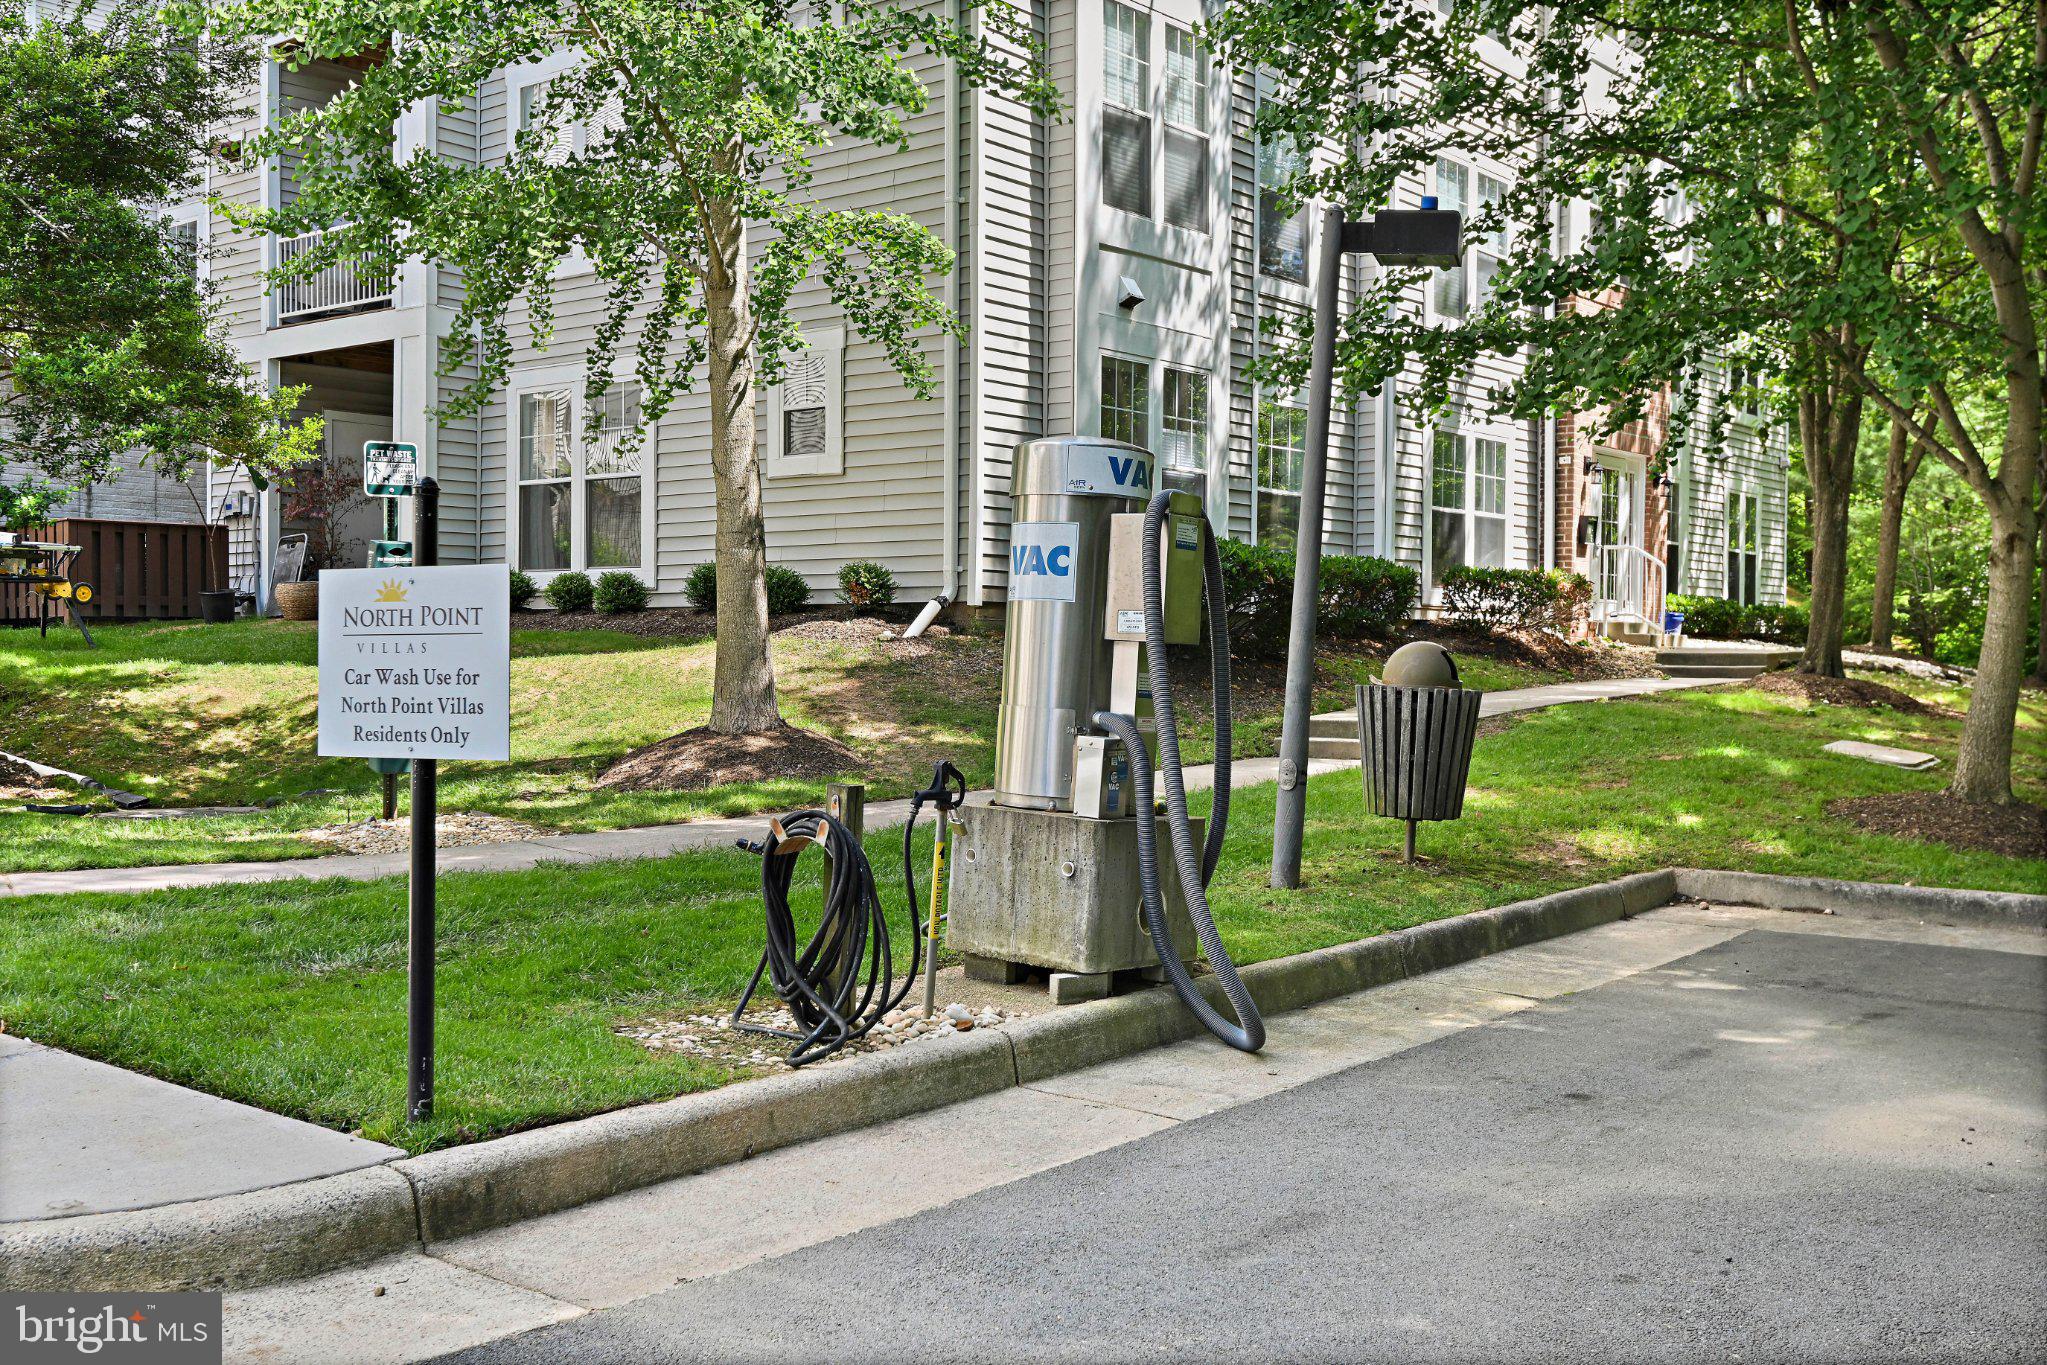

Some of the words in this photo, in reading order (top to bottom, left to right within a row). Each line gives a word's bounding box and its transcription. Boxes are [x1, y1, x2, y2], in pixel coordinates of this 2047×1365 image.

[370, 449, 384, 457] PET
[387, 450, 412, 458] WASTE
[1108, 456, 1152, 489] VA
[1013, 545, 1071, 576] VAC
[343, 606, 413, 628] NORTH
[420, 605, 483, 626] POINT
[357, 642, 427, 654] VILLAS
[344, 668, 371, 685] Car
[374, 668, 419, 685] Wash
[423, 668, 451, 686] Use
[455, 667, 480, 686] for
[341, 696, 387, 714] North
[391, 697, 433, 714] Point
[437, 697, 484, 715] Villas
[353, 725, 427, 743] Residents
[430, 726, 470, 748] Only
